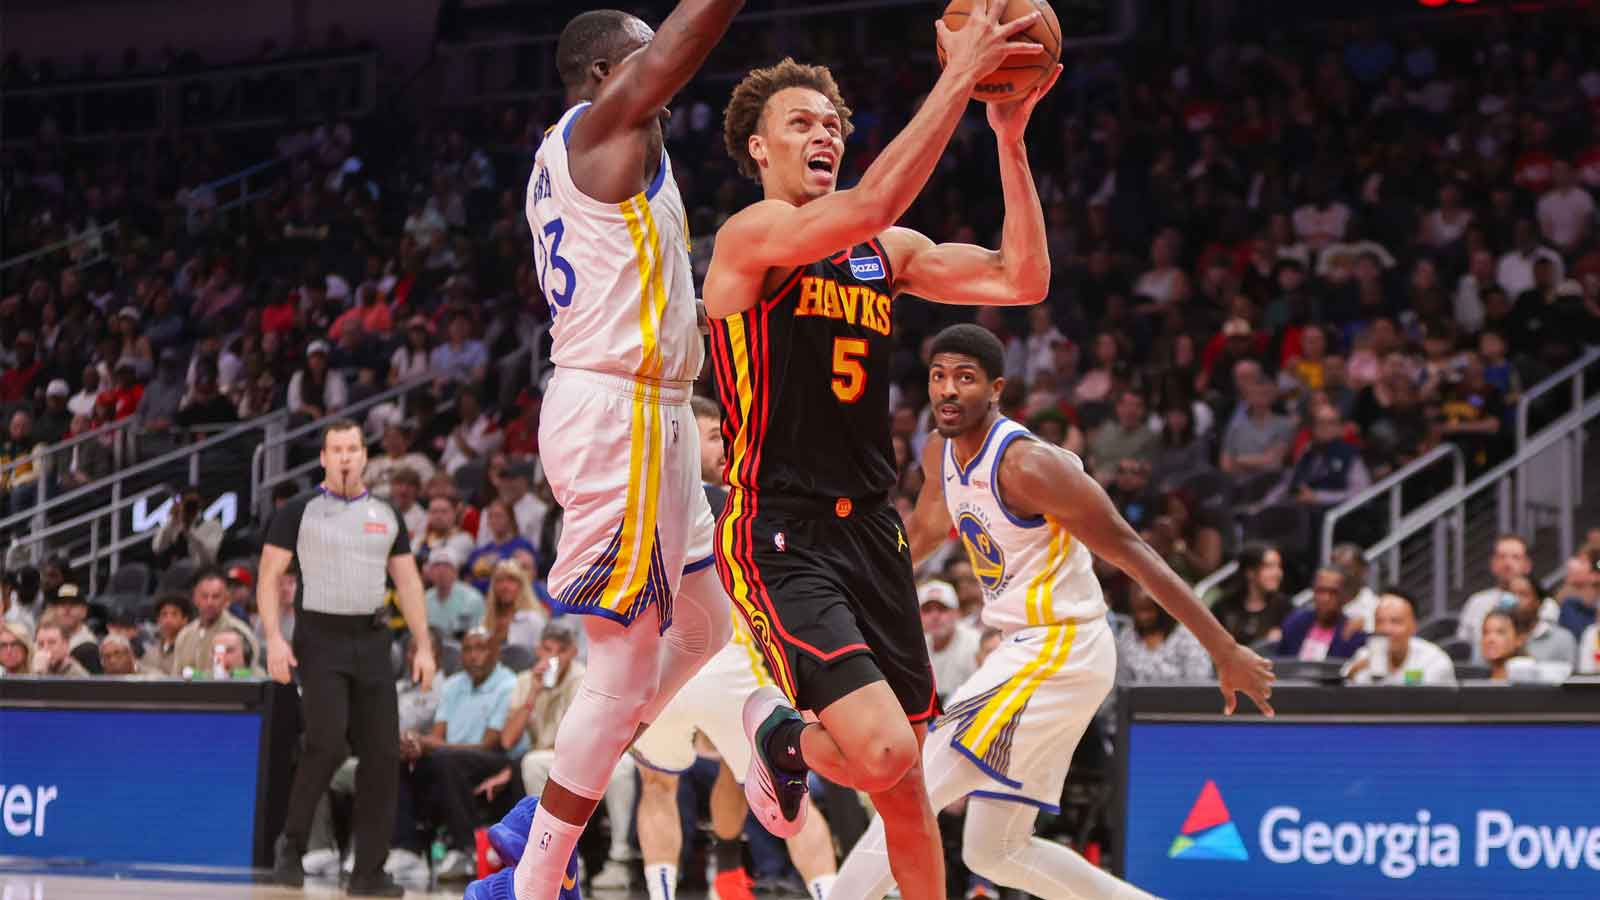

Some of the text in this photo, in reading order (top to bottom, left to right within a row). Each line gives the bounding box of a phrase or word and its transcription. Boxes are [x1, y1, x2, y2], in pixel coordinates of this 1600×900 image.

[831, 335, 869, 404] 5
[132, 487, 237, 533] KA
[0, 784, 58, 837] er
[1258, 805, 1460, 879] Georgia
